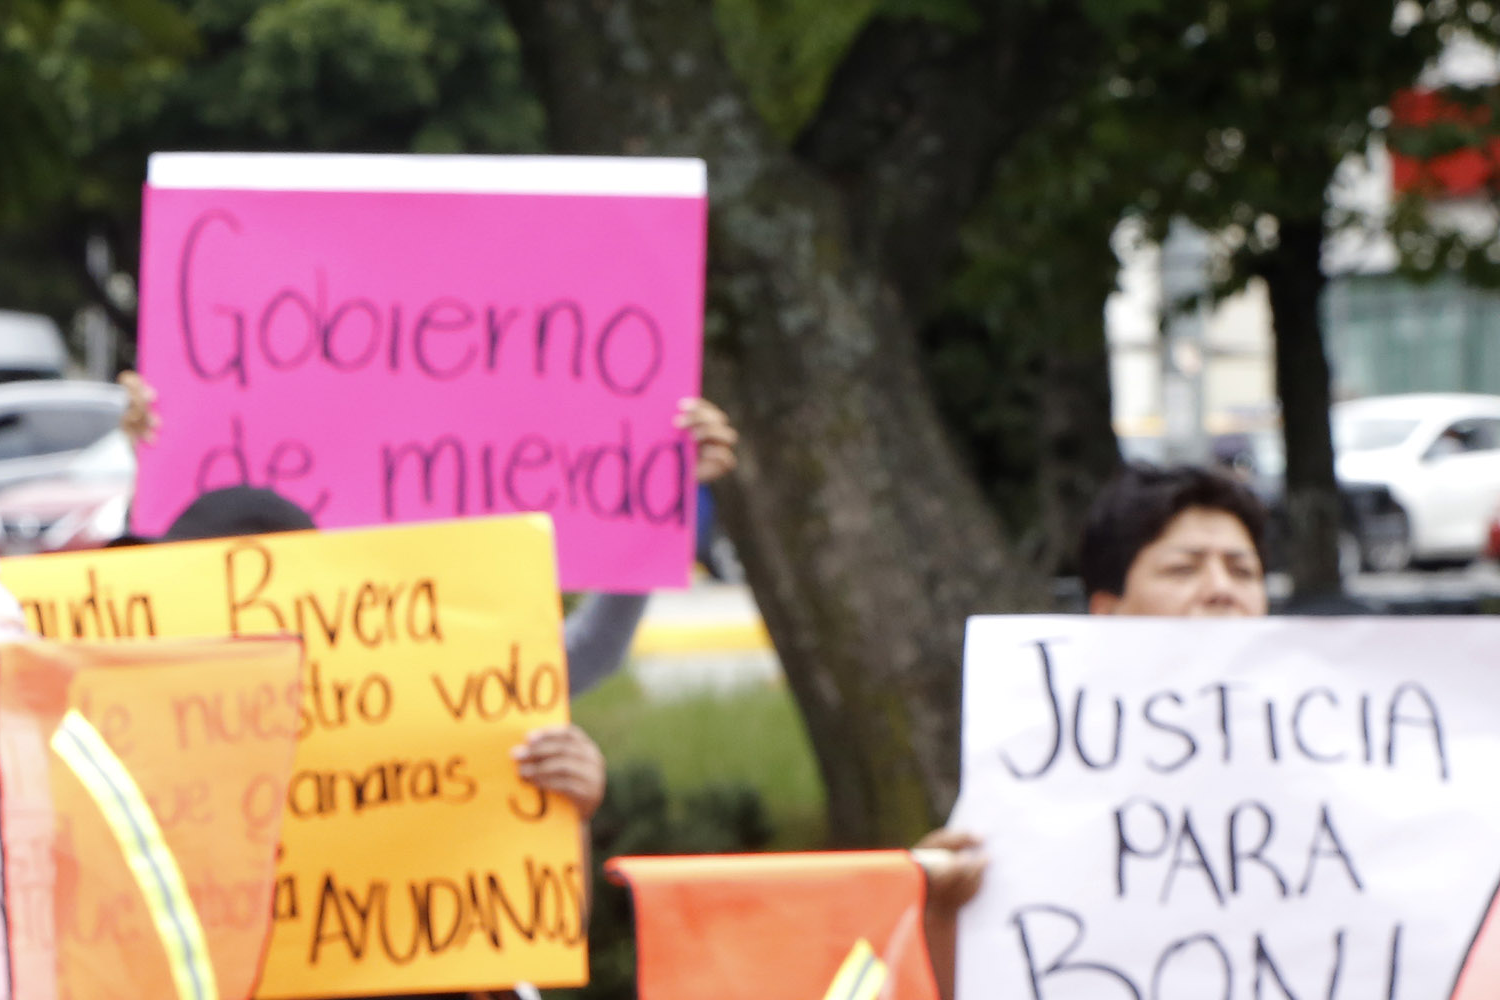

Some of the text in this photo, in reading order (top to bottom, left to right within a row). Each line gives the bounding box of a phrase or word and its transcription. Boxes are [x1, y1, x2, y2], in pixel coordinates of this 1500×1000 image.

[177, 207, 664, 398] Gobierno
[380, 420, 688, 528] mierda
[224, 538, 445, 652] Rivera
[999, 635, 1449, 783] JUSTICIA
[1112, 796, 1365, 907] PARA
[307, 858, 585, 965] AYUDANOS
